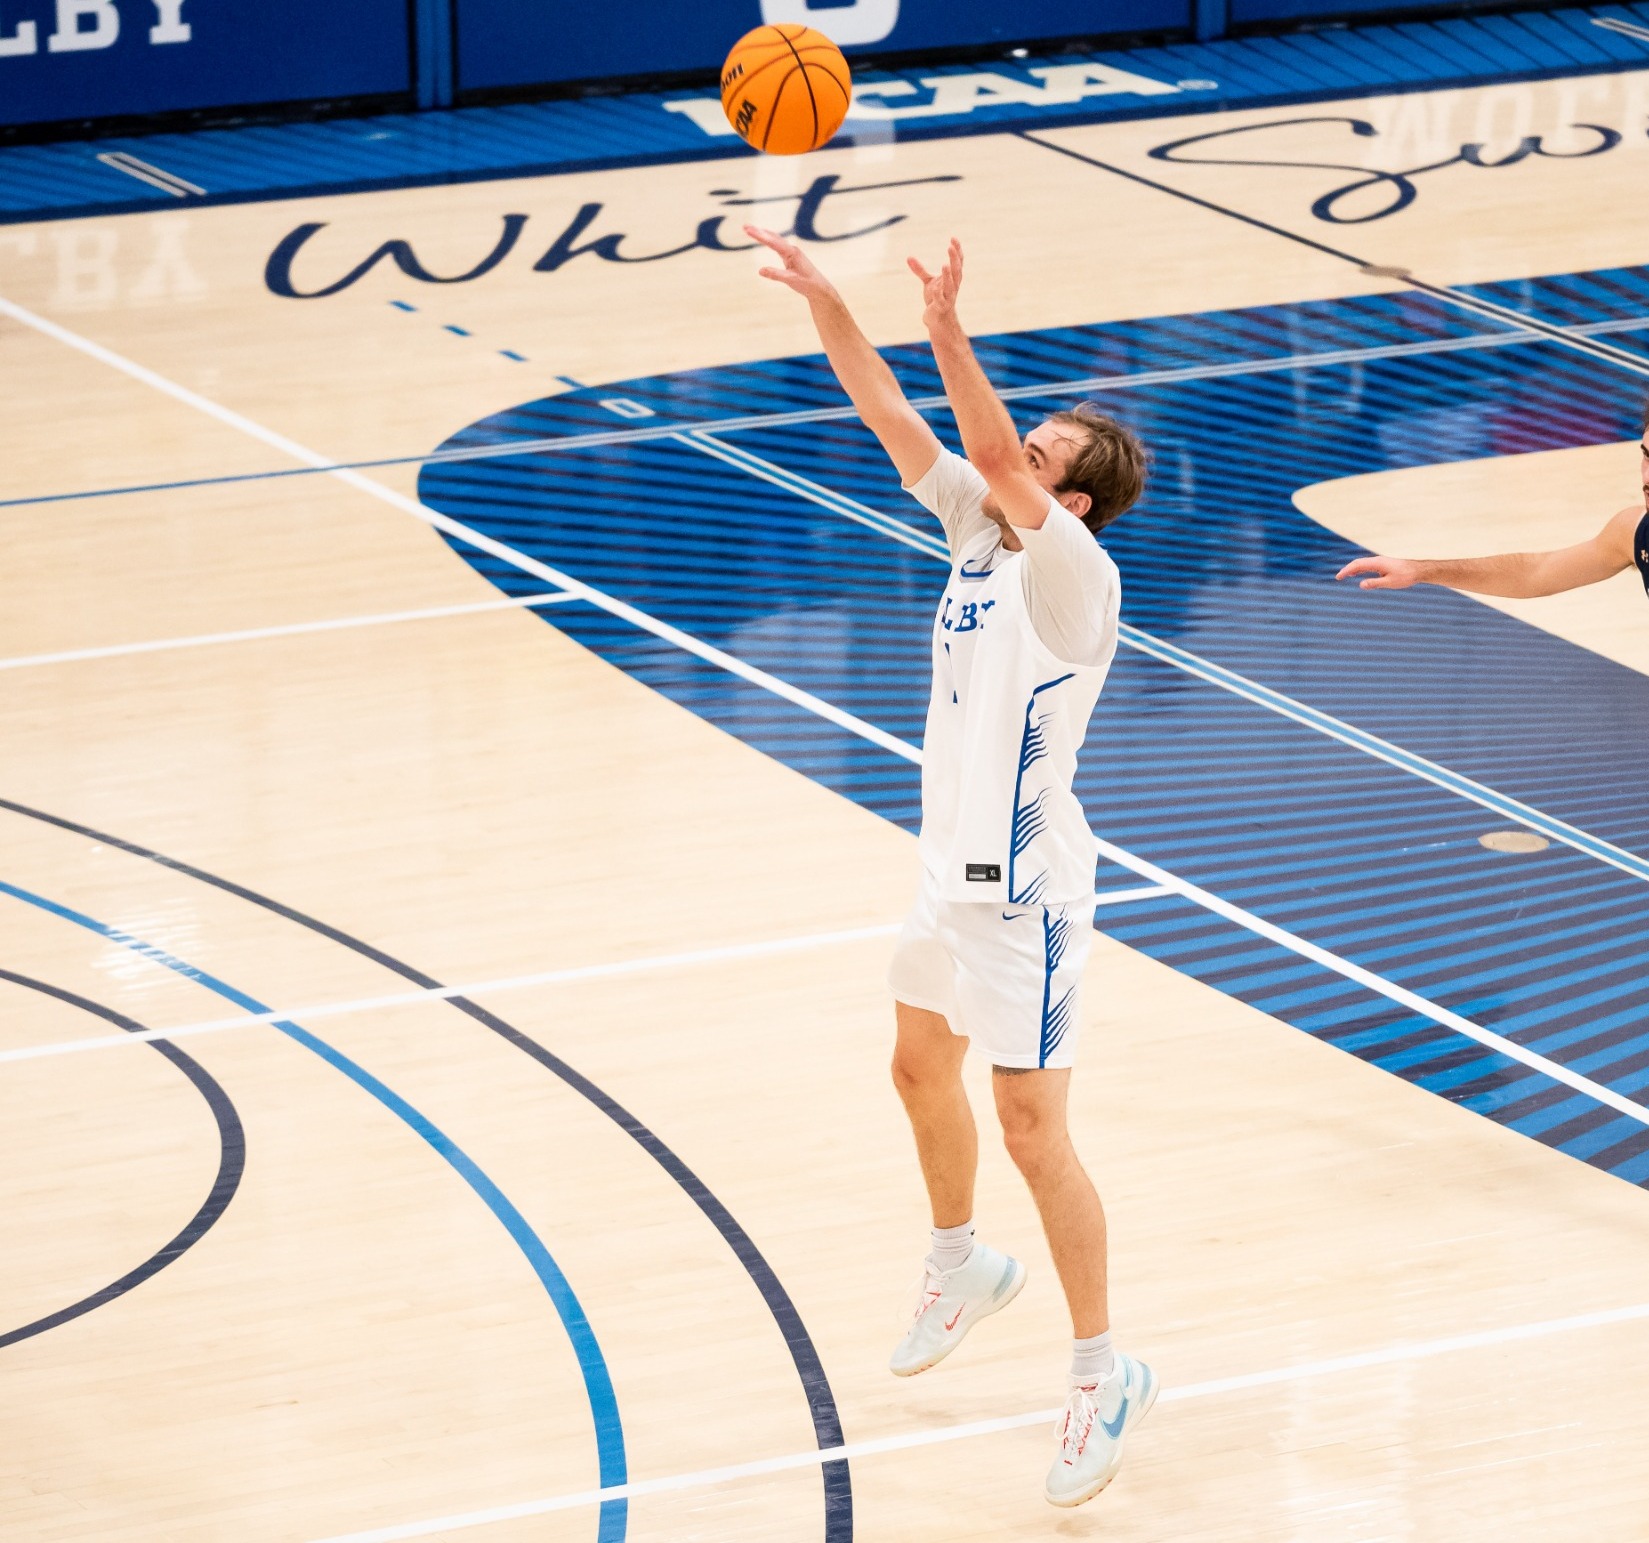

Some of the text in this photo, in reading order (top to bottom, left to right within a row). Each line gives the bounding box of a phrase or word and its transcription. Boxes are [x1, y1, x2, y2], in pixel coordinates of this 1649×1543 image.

[1147, 117, 1649, 225] Sw
[264, 174, 962, 299] Whit
[989, 869, 997, 877] XL
